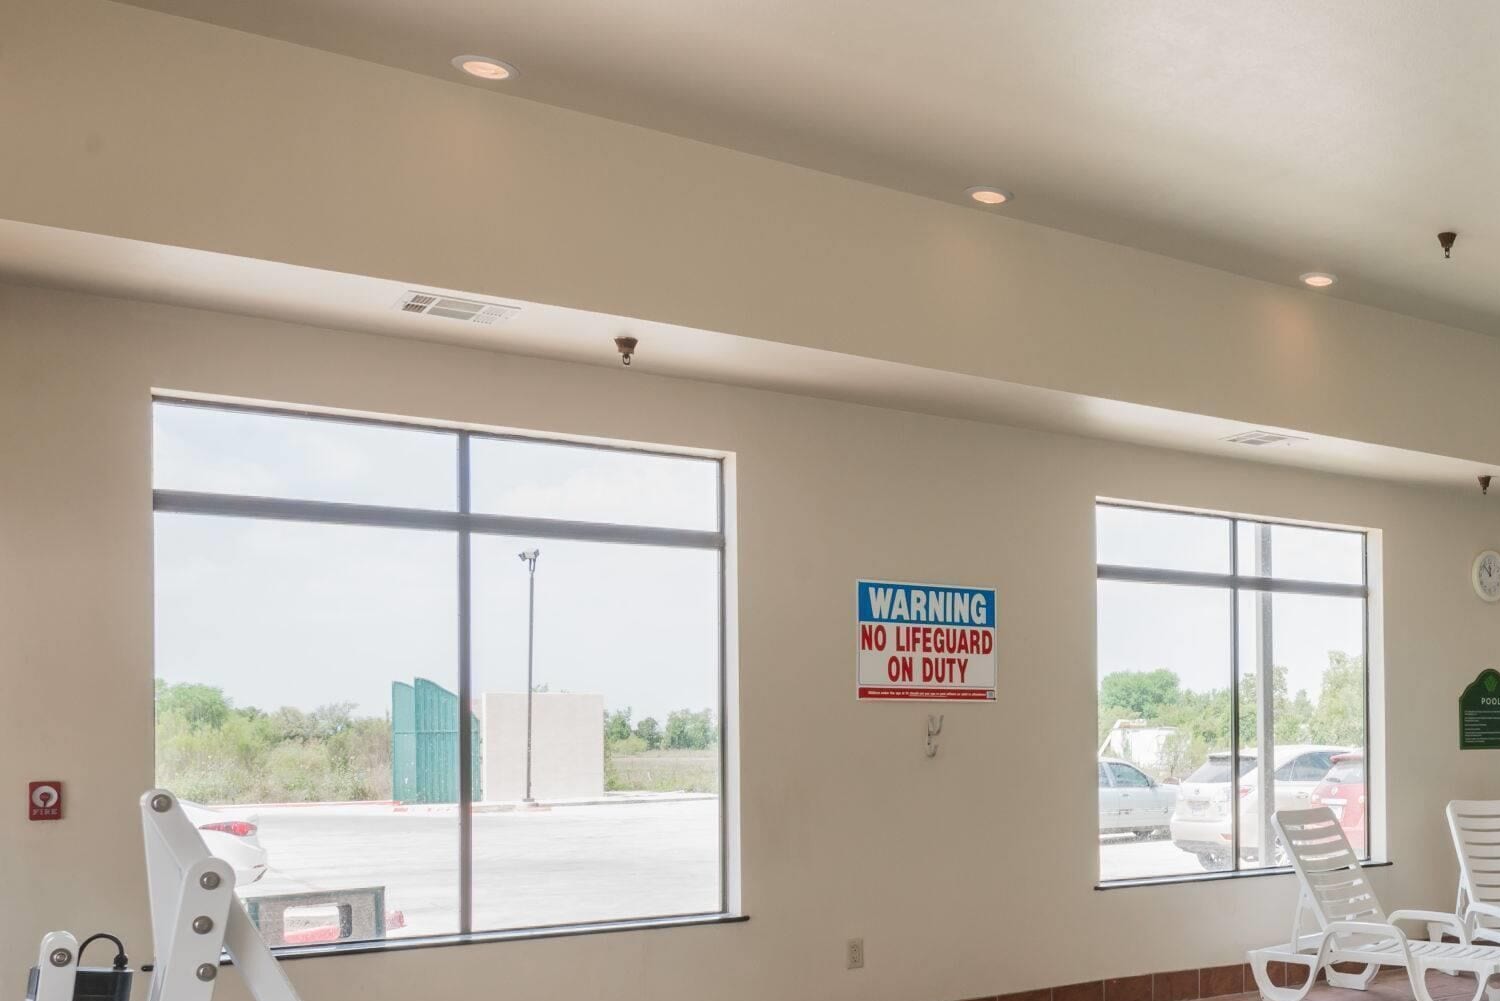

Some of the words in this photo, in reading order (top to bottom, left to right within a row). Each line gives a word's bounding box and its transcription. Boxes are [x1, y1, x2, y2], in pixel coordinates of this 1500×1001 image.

[868, 586, 987, 625] WARNING
[861, 624, 887, 651] NO
[896, 626, 993, 655] LIFEGUARD
[888, 655, 913, 683] ON
[922, 657, 969, 684] DUTY
[32, 808, 58, 816] FIRE
